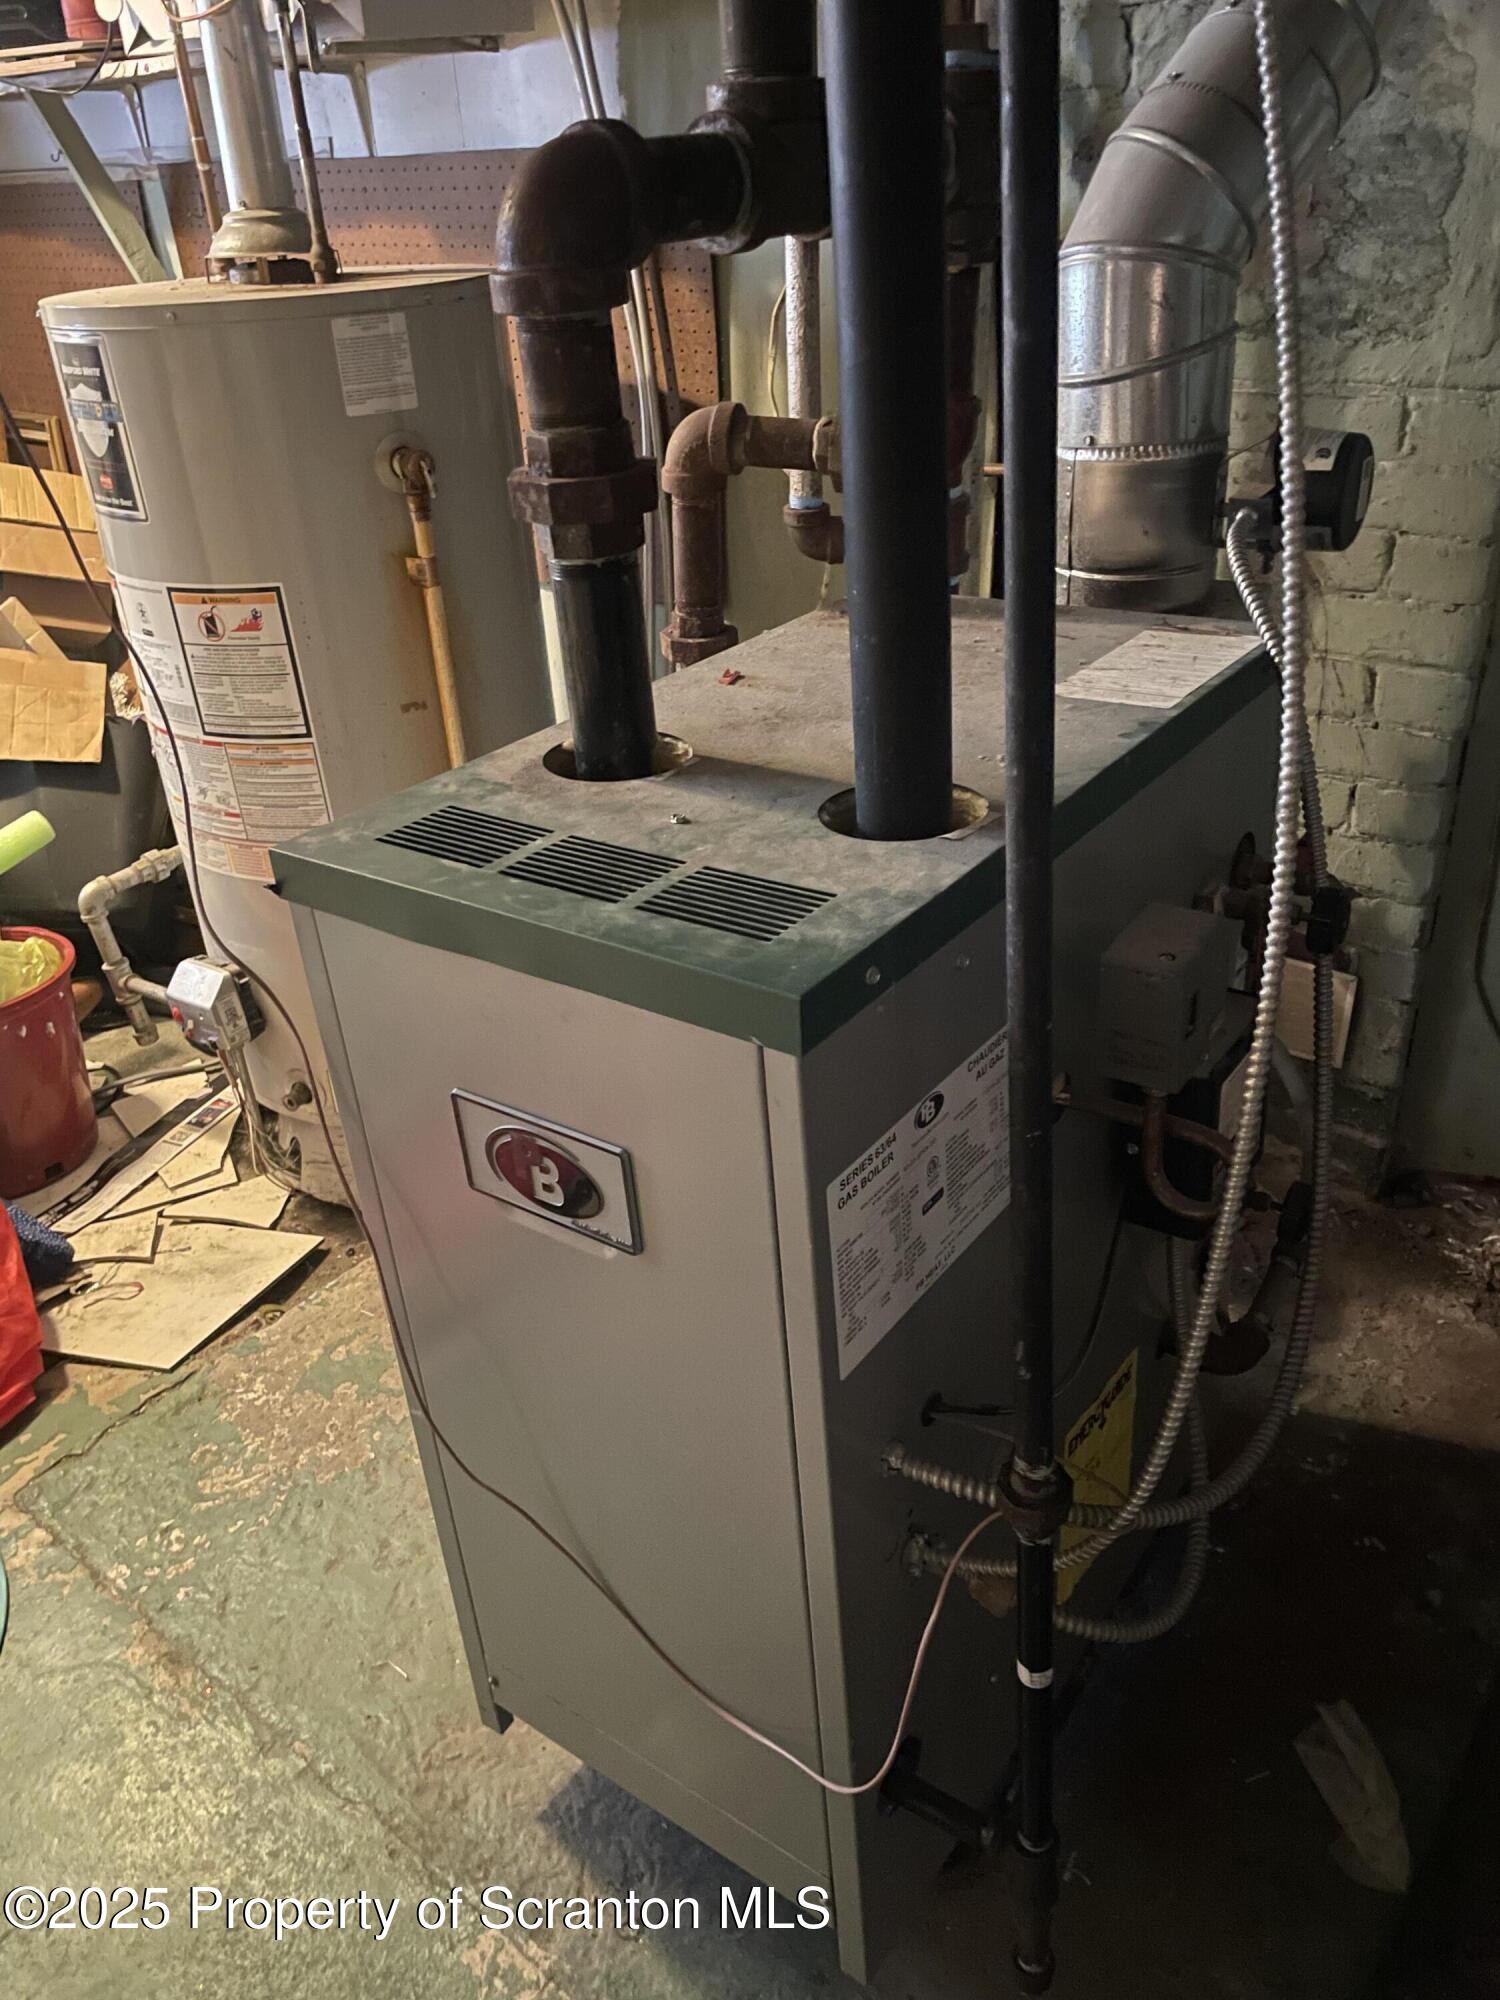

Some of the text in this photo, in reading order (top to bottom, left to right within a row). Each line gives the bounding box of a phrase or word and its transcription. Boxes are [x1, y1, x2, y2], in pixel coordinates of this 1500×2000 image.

[837, 1184, 859, 1210] GAS
[860, 1151, 895, 1189] BOILER
[839, 1153, 874, 1192] SERIES
